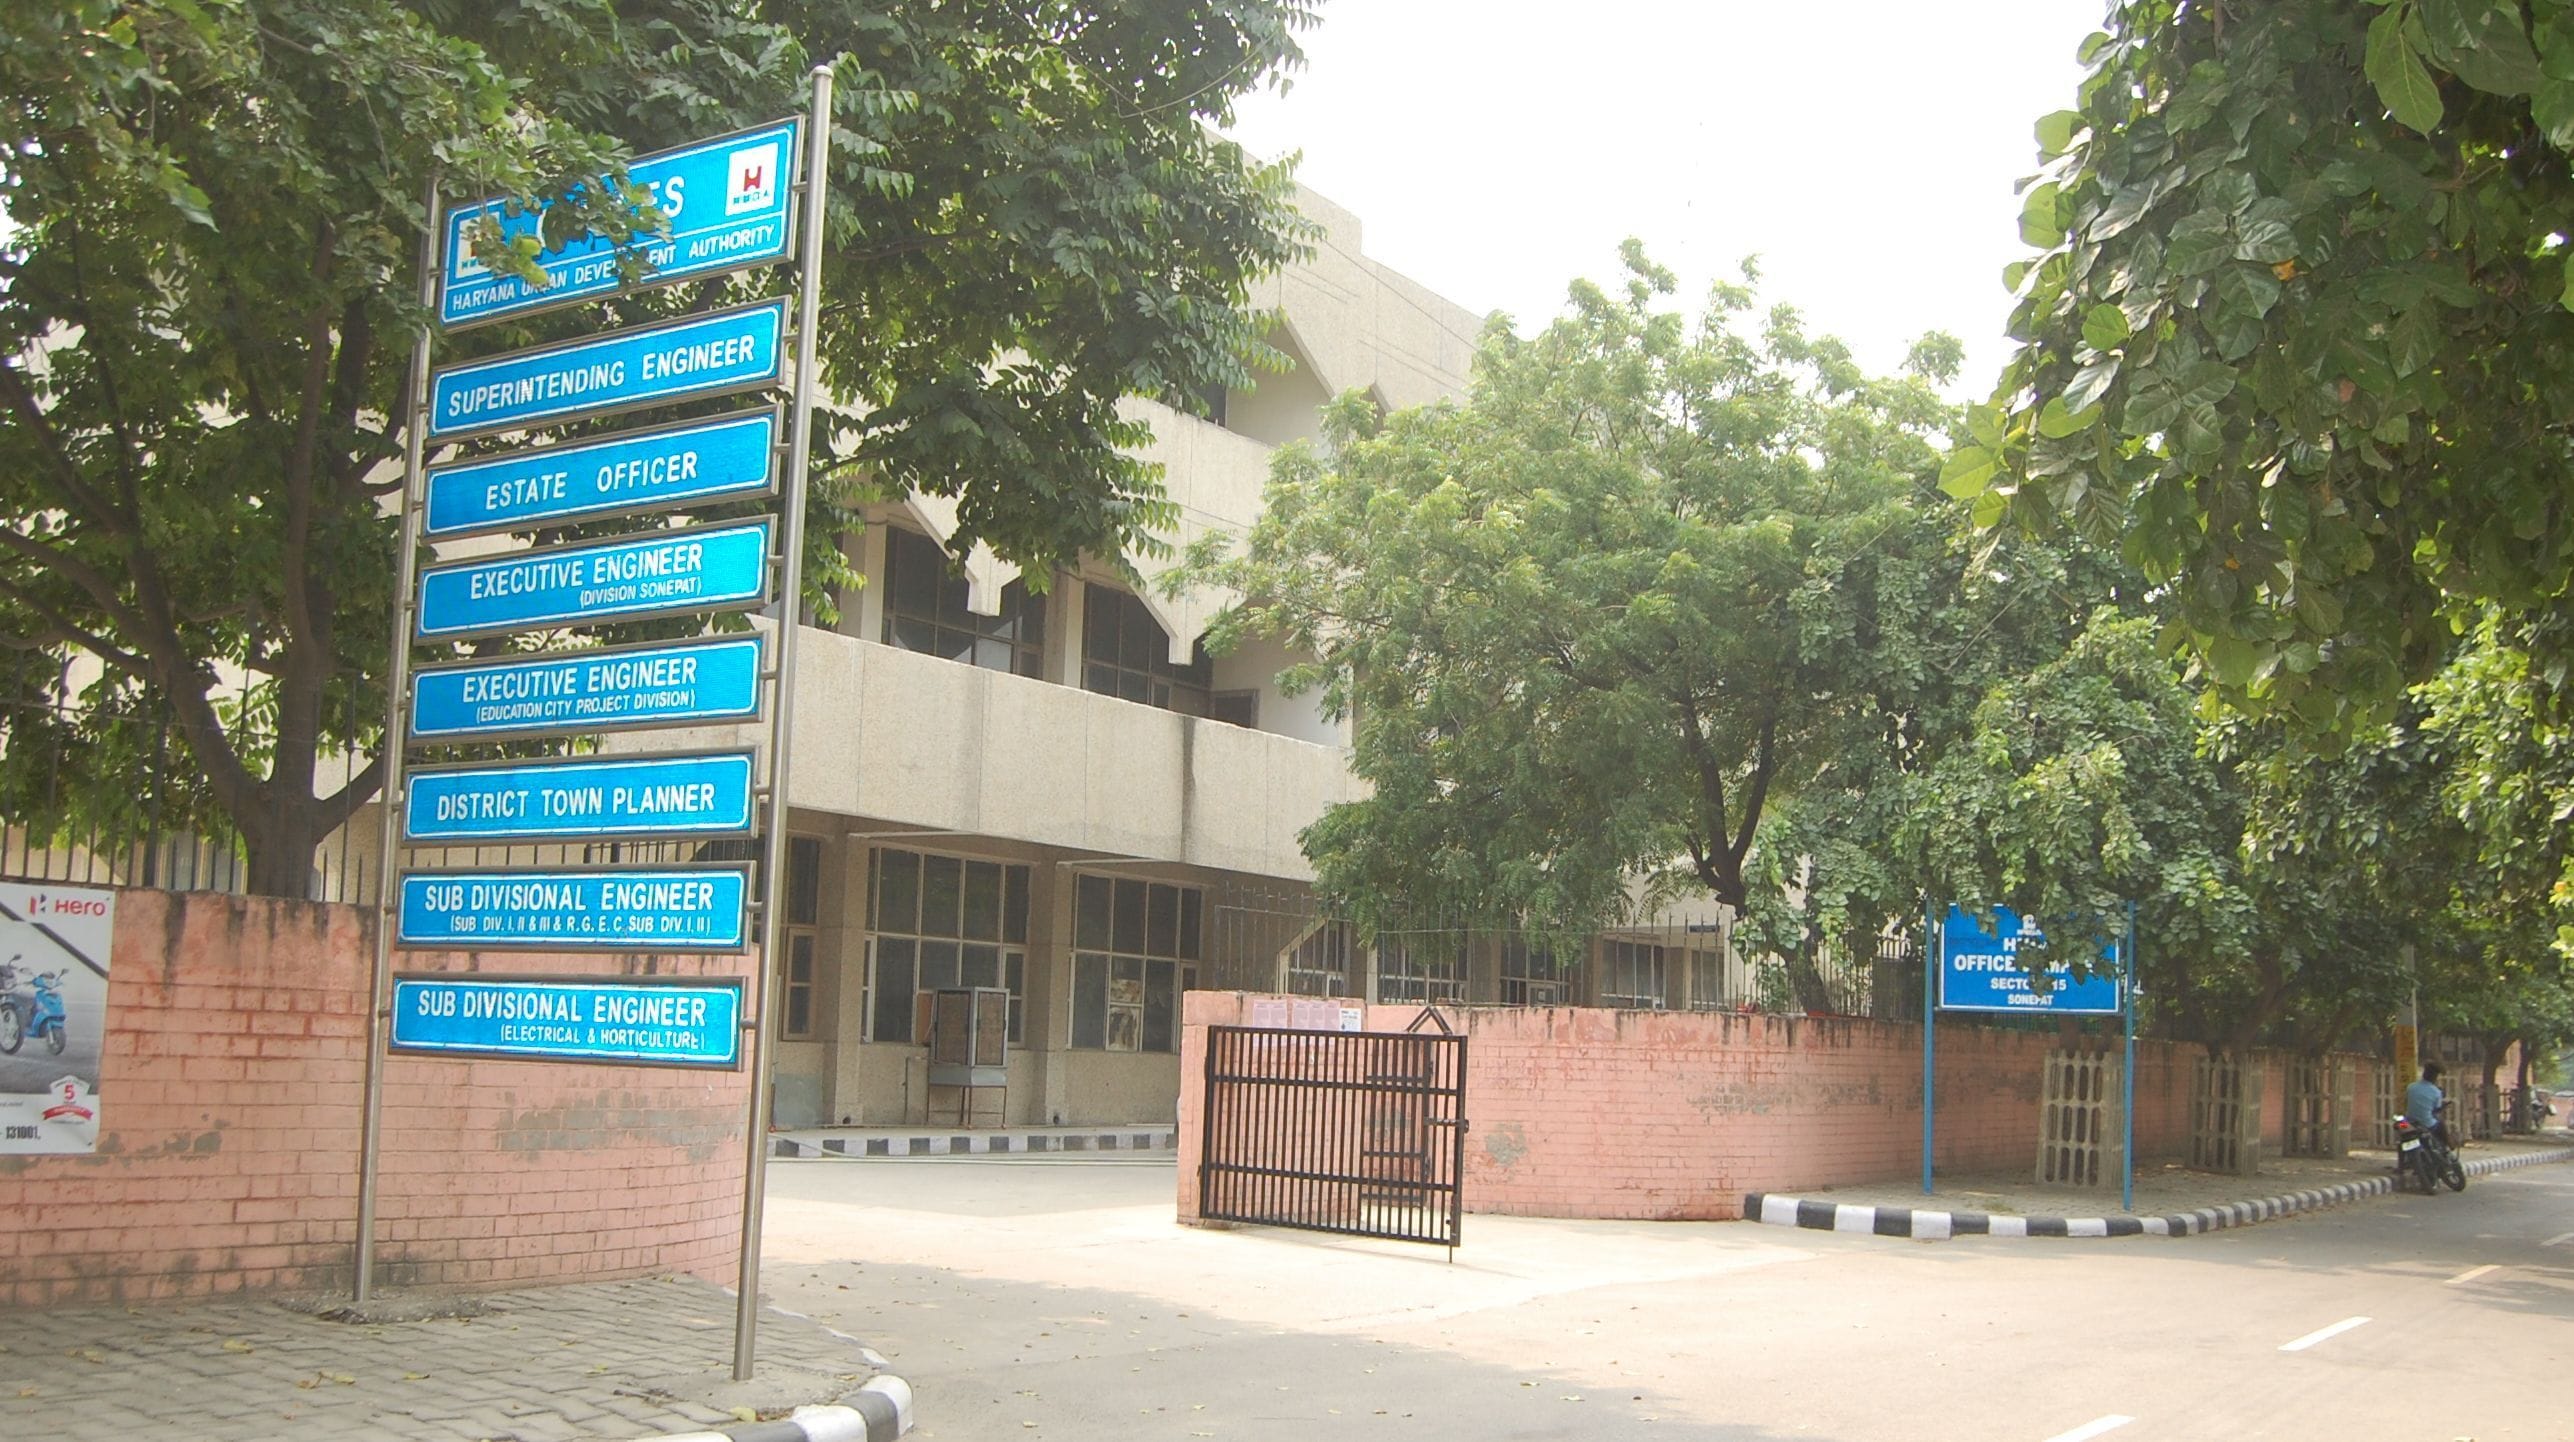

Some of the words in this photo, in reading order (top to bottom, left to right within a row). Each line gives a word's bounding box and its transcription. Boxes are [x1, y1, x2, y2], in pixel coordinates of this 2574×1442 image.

[452, 282, 516, 312] HARYANA
[521, 269, 568, 297] UAN
[574, 245, 677, 285] DEVEENT
[689, 224, 774, 259] AUTHORITY
[448, 360, 624, 417] SUPERINTENDING
[642, 335, 755, 380] ENGINEER
[486, 472, 567, 510] ESTATE
[597, 451, 697, 492] OFFICER
[471, 560, 583, 600] EXECUTIVE
[593, 542, 702, 584] ENGINEER
[579, 587, 638, 609] (DIVISION
[638, 575, 703, 599] SONEPAT)
[463, 669, 577, 704] EXECUTIVE
[588, 657, 697, 692] ENGINEER
[475, 702, 543, 724] (EDUCATION
[544, 700, 572, 718] CITY
[575, 694, 631, 714] PROJECT
[633, 688, 697, 710] DIVISION)
[438, 790, 529, 821] DISTRICT
[541, 787, 603, 816] TOWN
[613, 783, 715, 814] PLANNER
[54, 899, 106, 916] Hero
[425, 885, 463, 912] SUB
[471, 883, 586, 911] DIVISIONAL
[601, 882, 714, 911] ENGINEER
[450, 914, 477, 933] (SUB
[483, 914, 505, 933] DIV.
[528, 914, 538, 932] &
[552, 914, 562, 932] &
[628, 914, 654, 933] SUB
[1954, 954, 2016, 972] OFFICE
[1990, 976, 2036, 990] SECTO
[418, 990, 456, 1017] SUB
[464, 991, 582, 1022] DIVISIONAL
[594, 995, 706, 1027] ENGINEER
[500, 1024, 580, 1044] (ELECTRICAL
[586, 1027, 596, 1045] &
[64, 1084, 75, 1100] 5
